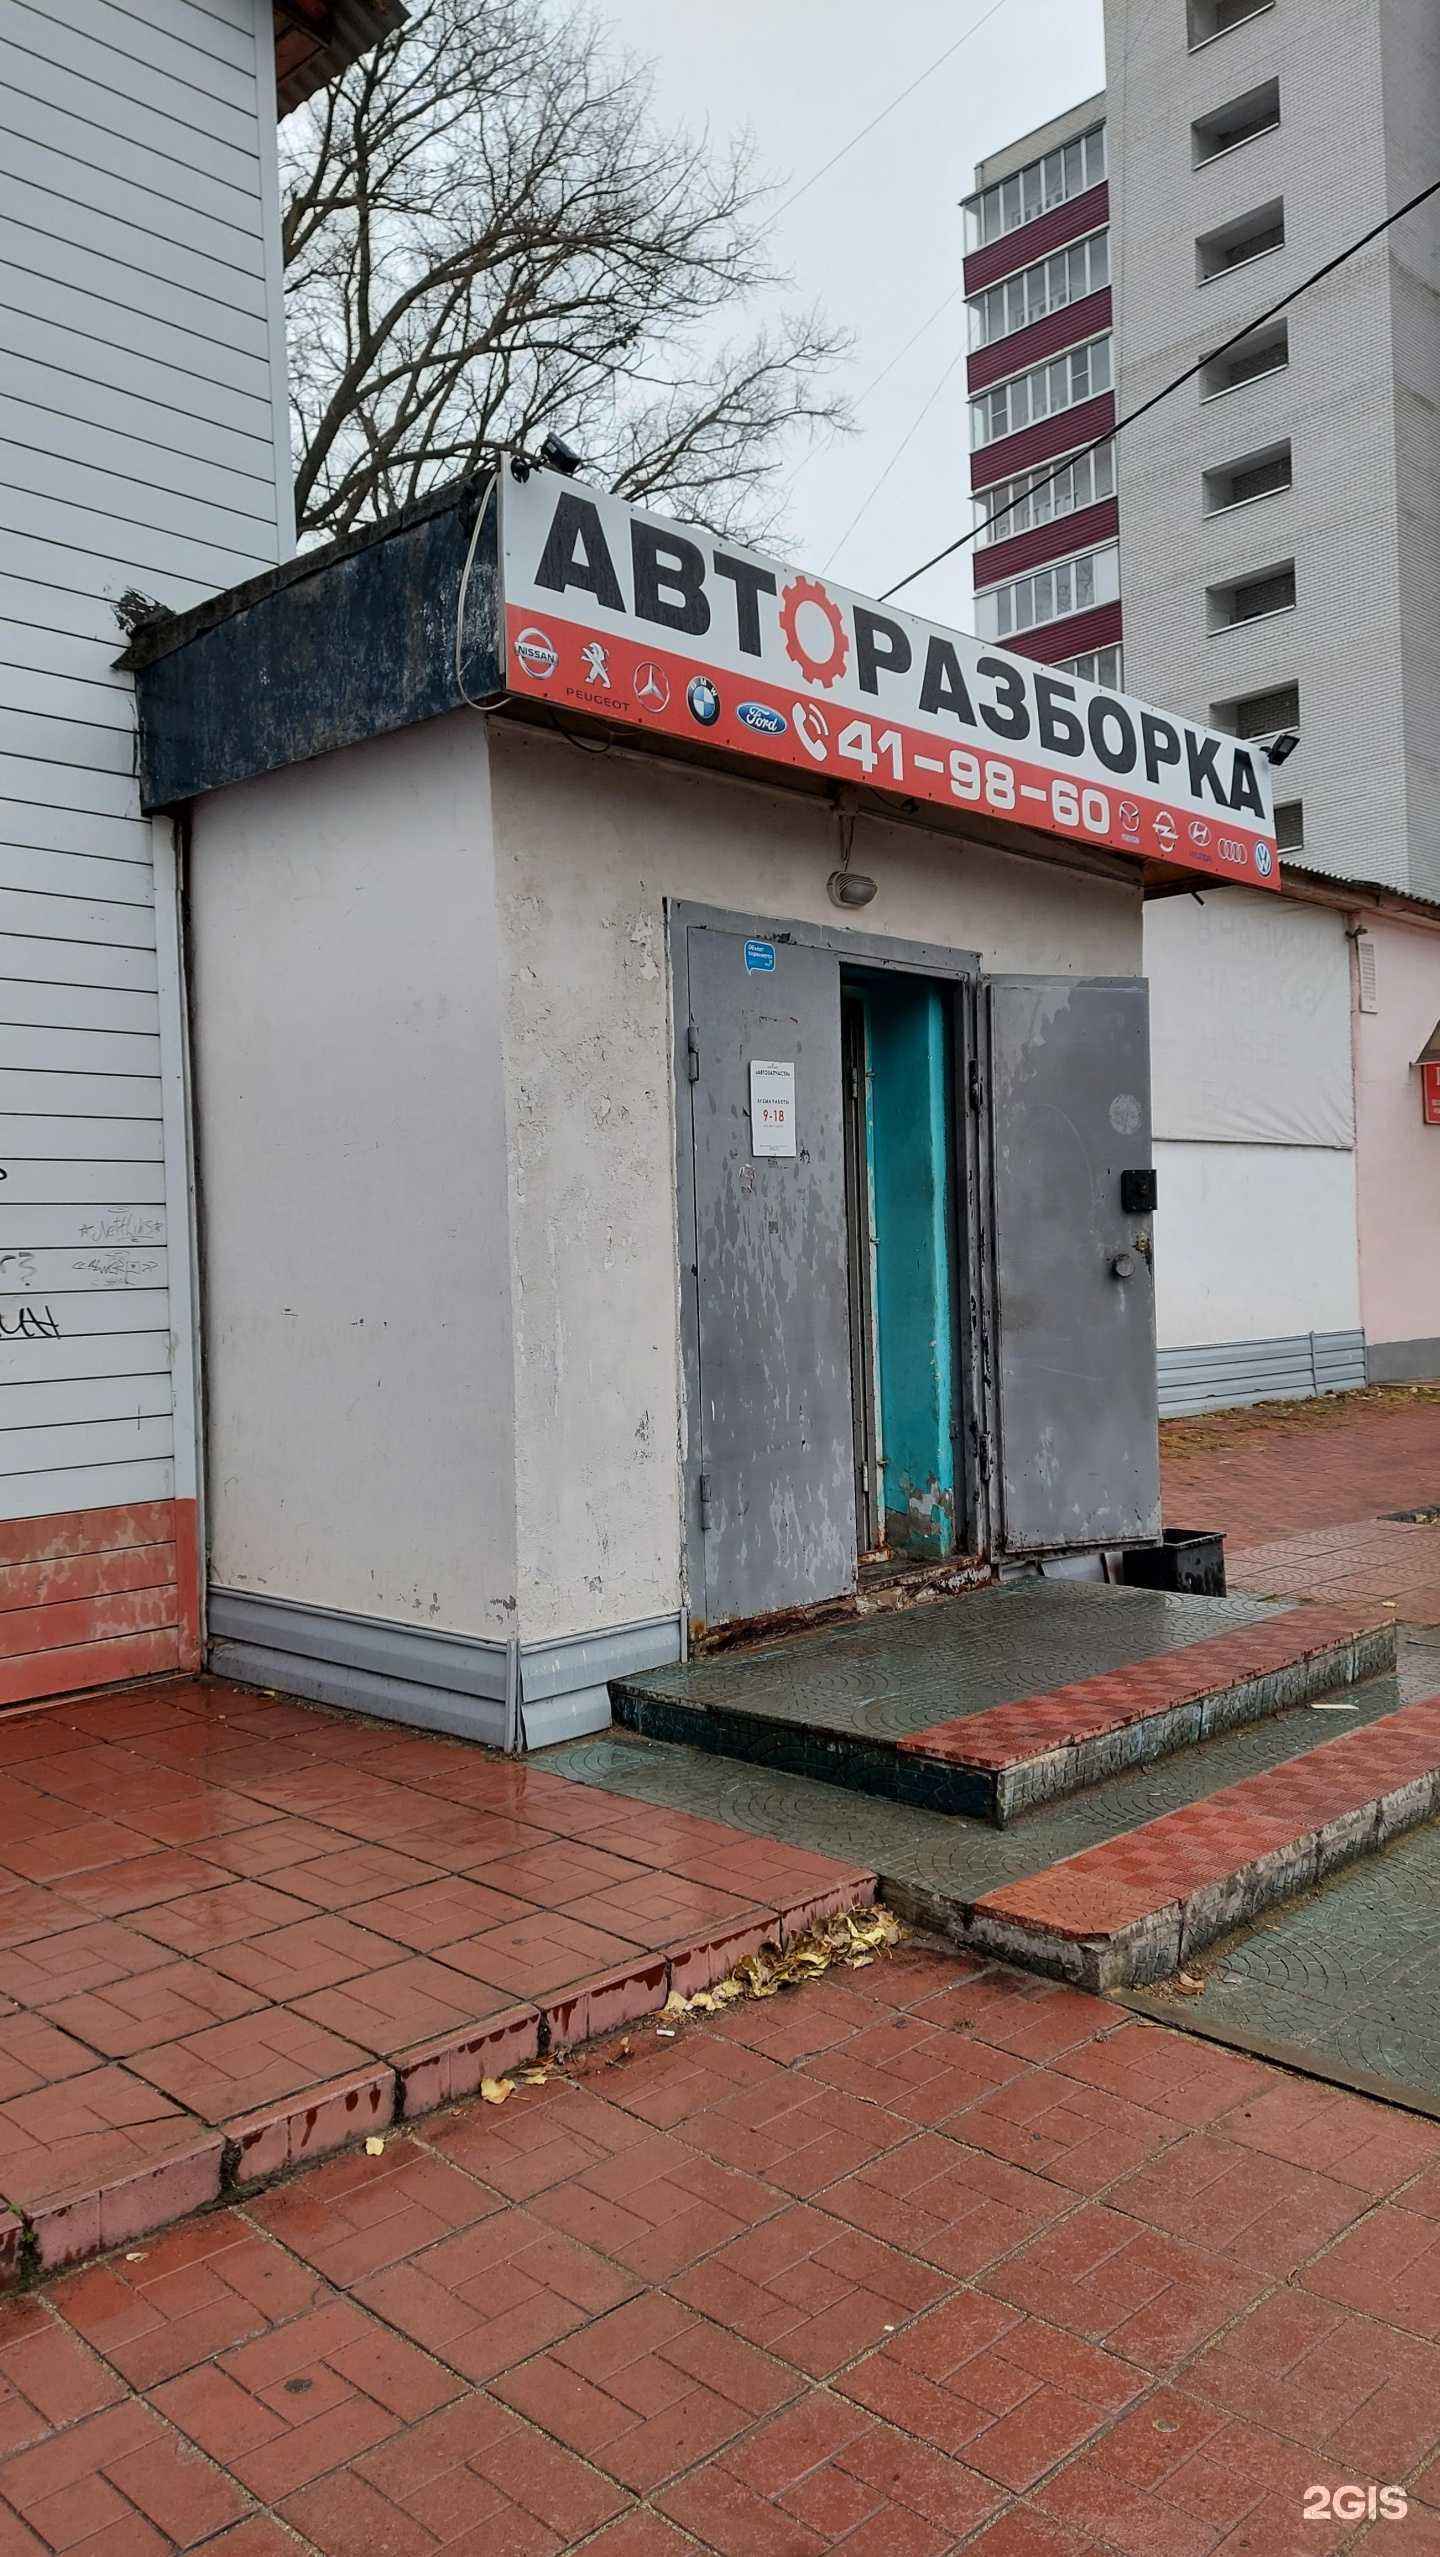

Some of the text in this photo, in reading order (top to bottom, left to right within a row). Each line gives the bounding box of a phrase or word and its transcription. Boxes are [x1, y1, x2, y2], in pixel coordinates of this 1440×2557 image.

[518, 645, 555, 663] NISSAN
[534, 491, 1265, 820] АВТОРАЗБОРКА
[566, 687, 630, 712] PEUGEOT
[746, 706, 778, 731] Ford
[838, 719, 1111, 834] 41-98-60
[763, 1109, 784, 1122] 9-18
